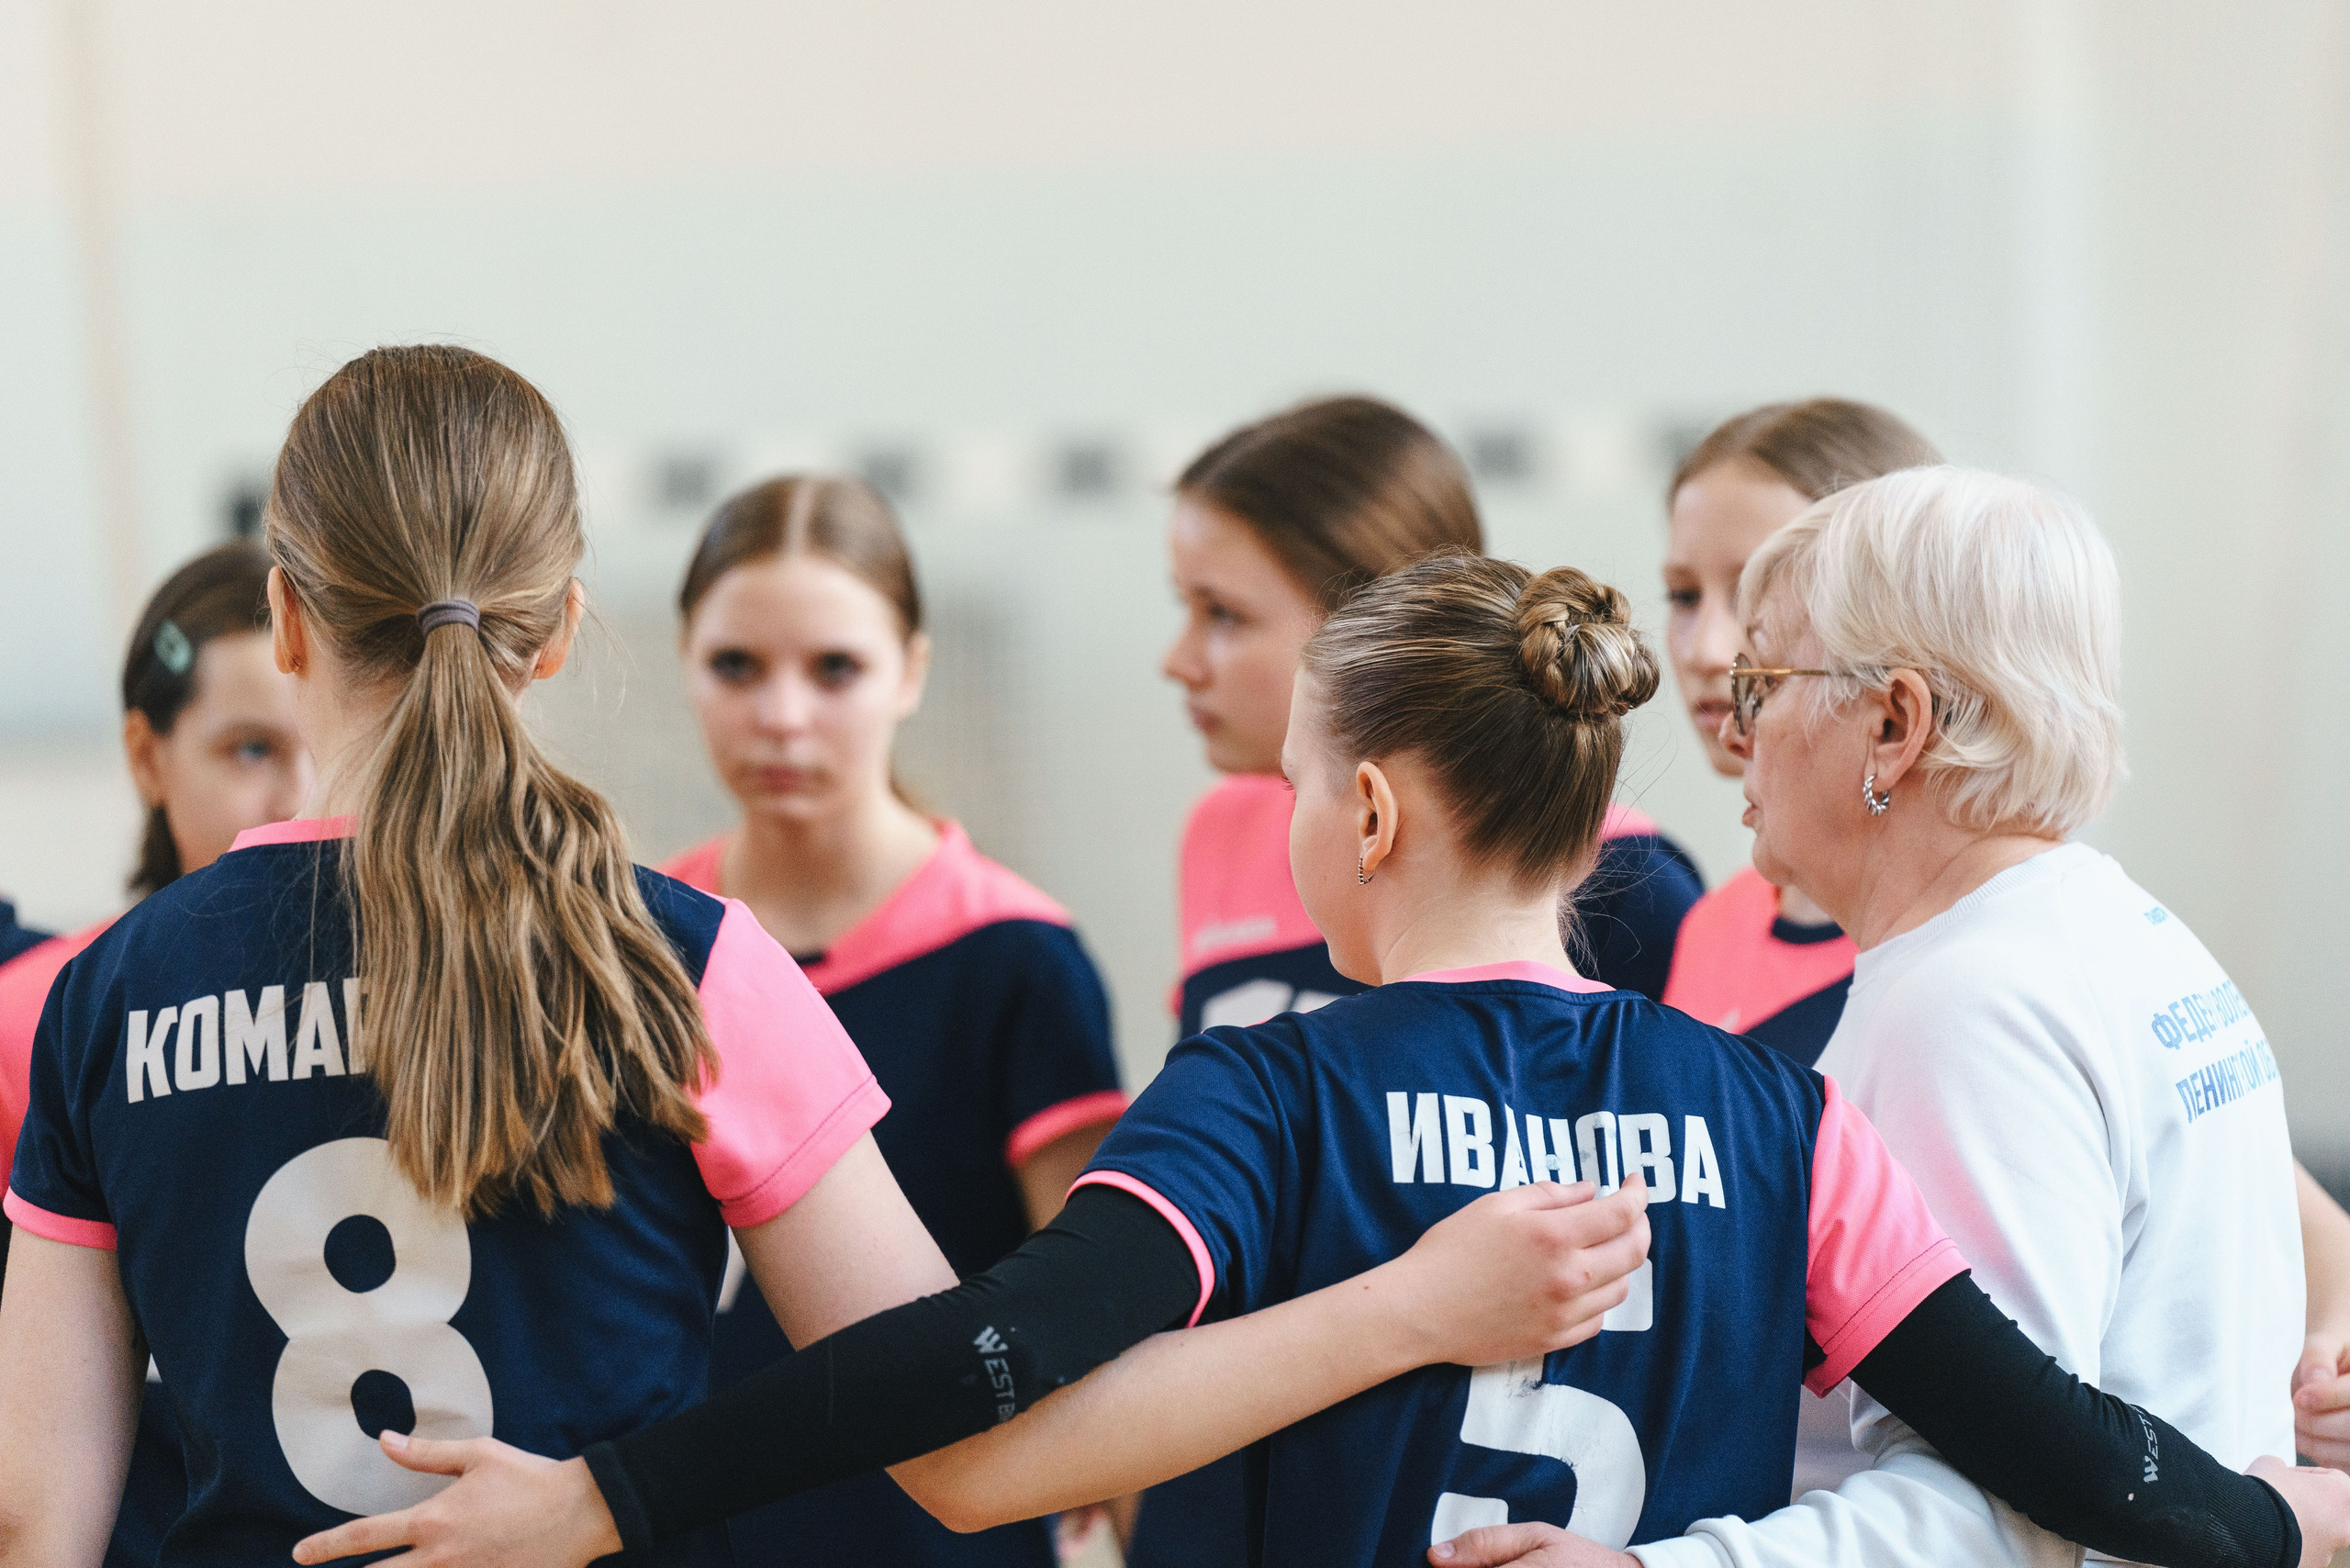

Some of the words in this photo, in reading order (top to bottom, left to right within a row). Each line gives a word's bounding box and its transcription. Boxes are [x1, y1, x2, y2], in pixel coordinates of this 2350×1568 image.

[1384, 1090, 1726, 1210] ИВАНОВА
[244, 1137, 494, 1518] 8
[1430, 1257, 1653, 1553] 5
[2137, 1414, 2158, 1483] WEST
